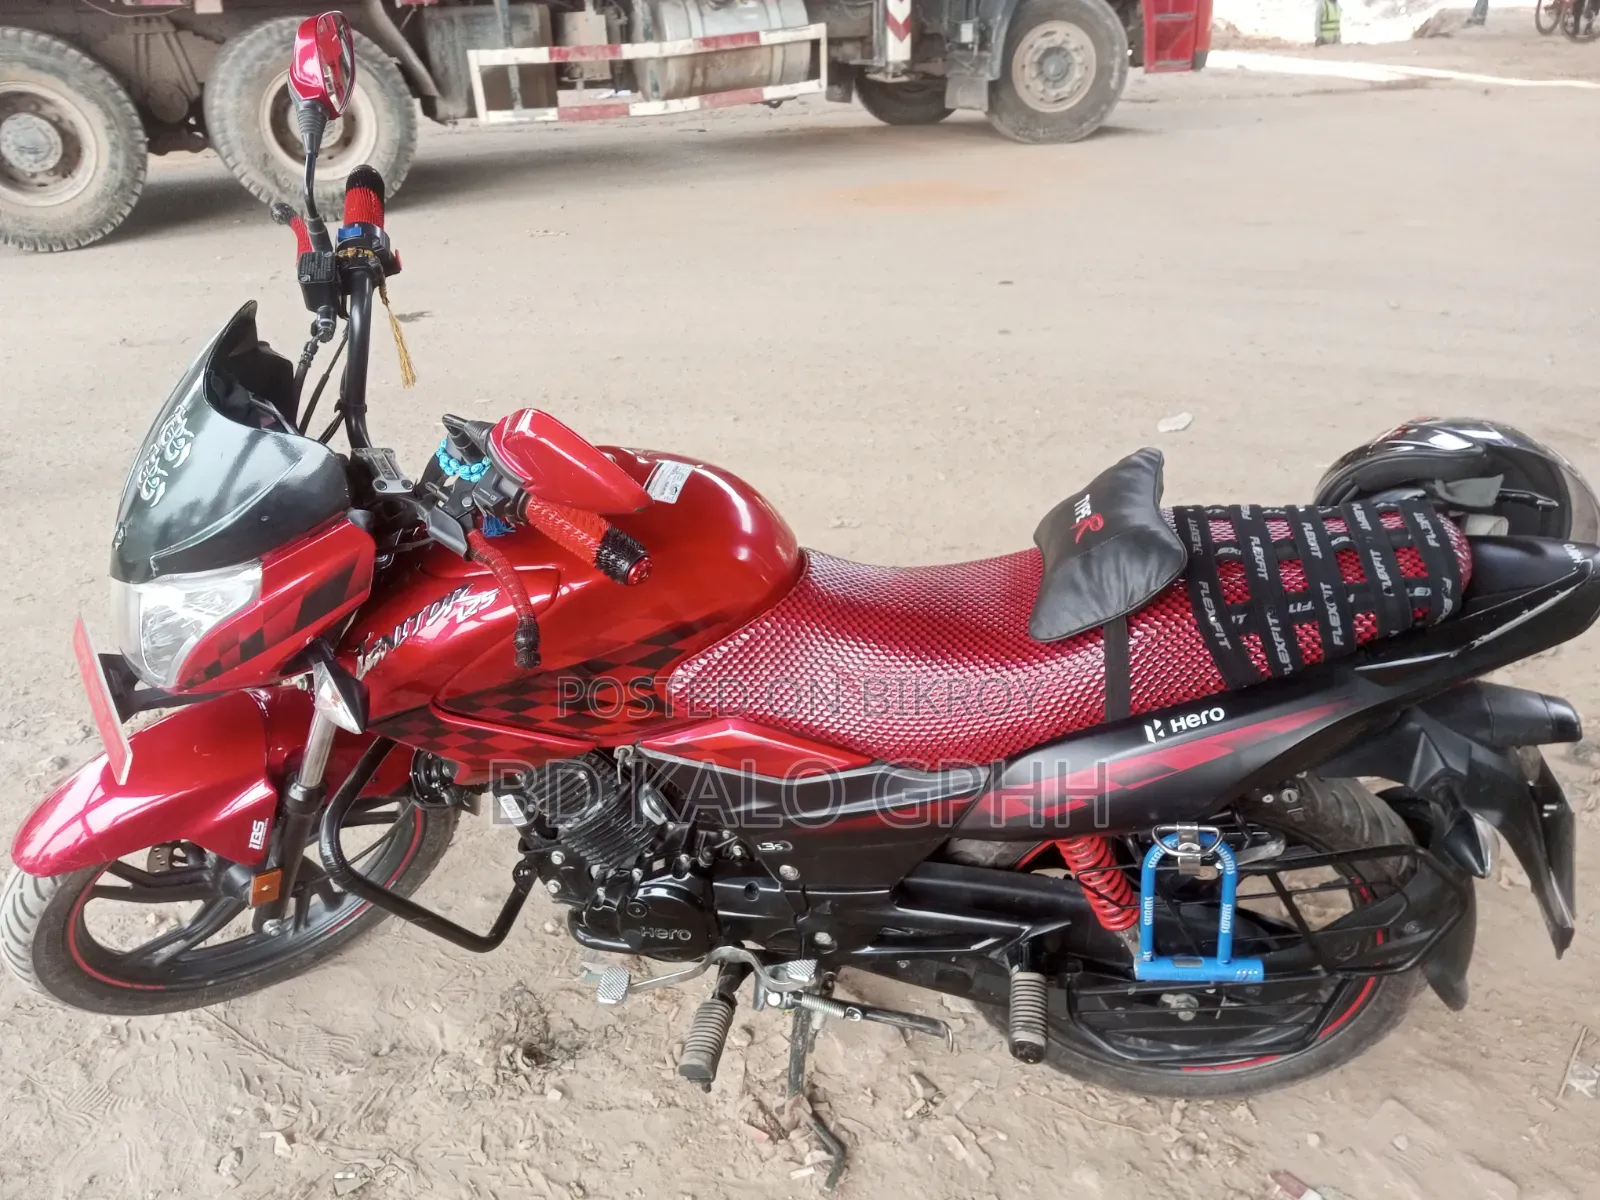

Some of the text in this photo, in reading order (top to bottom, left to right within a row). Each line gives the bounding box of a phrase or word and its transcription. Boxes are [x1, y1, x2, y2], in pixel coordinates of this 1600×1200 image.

[1250, 535, 1269, 581] FLEXFIT
[1198, 581, 1231, 650] FLEXFIT
[1170, 707, 1225, 733] Hero
[640, 926, 692, 941] Hero
